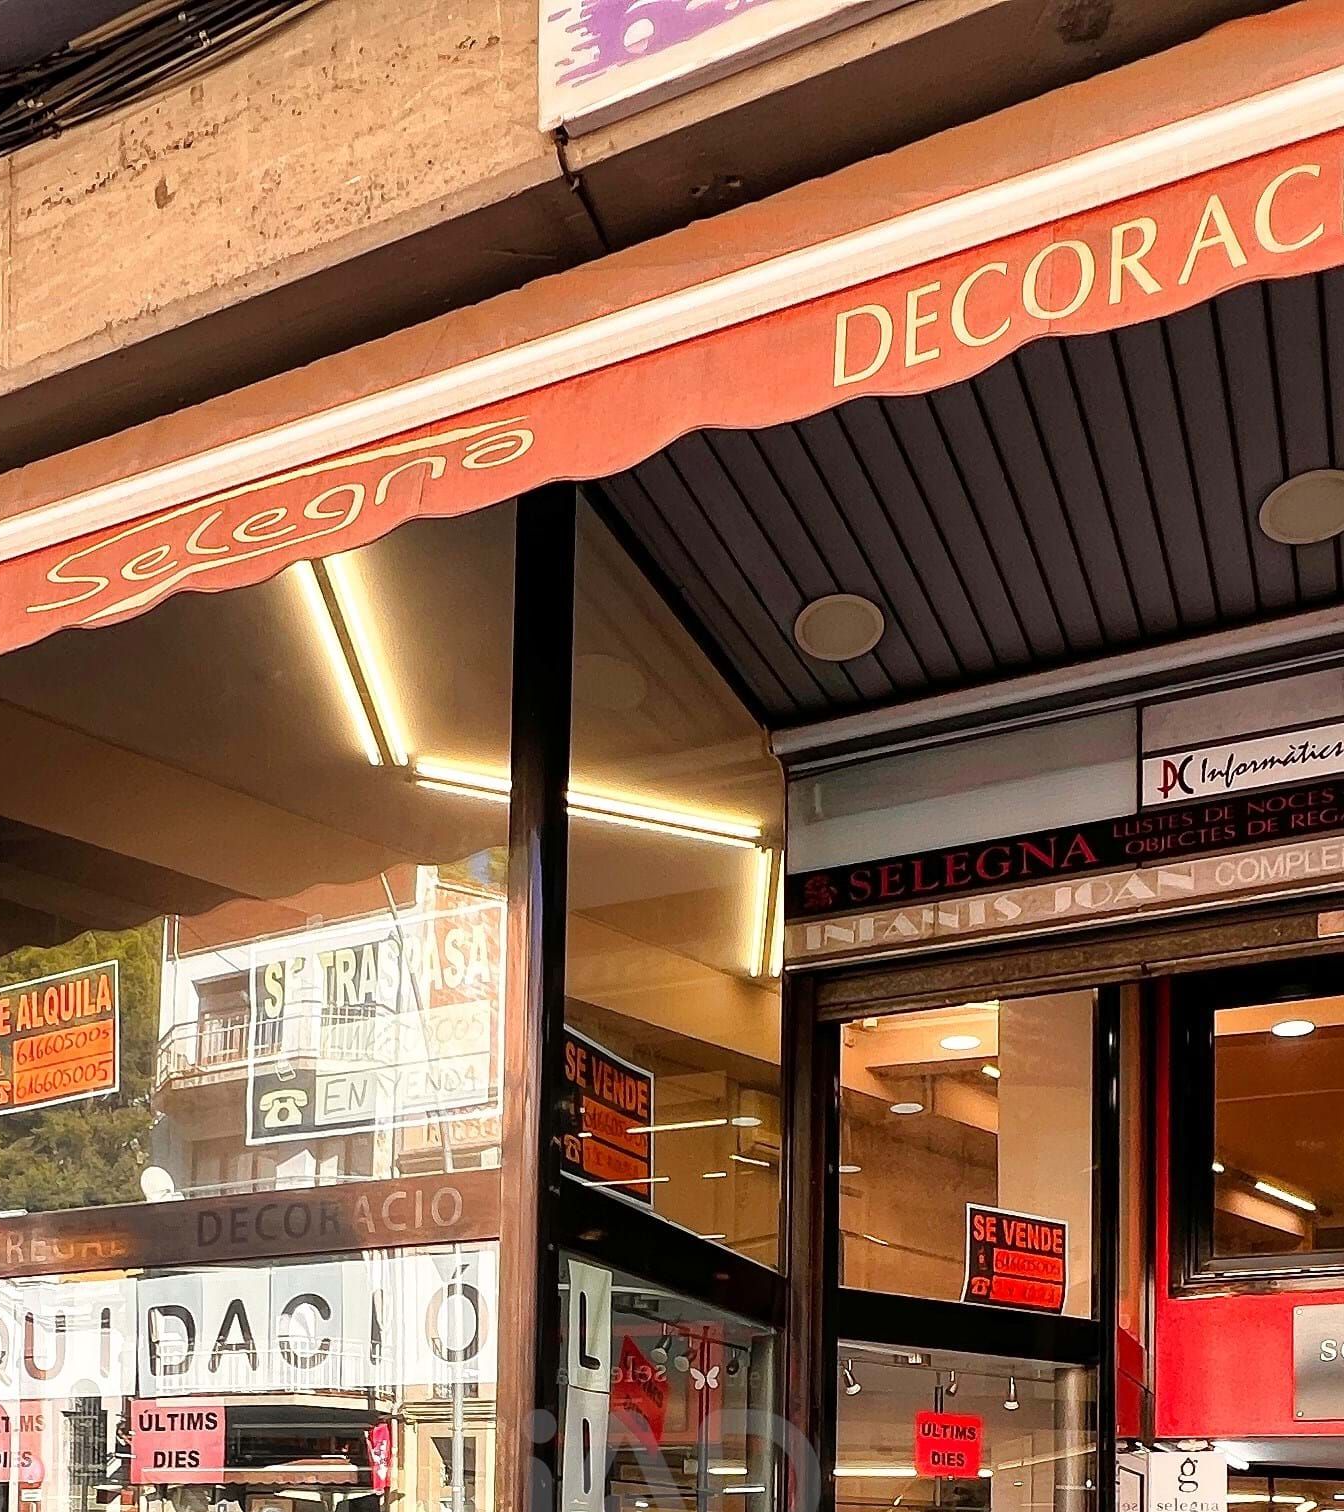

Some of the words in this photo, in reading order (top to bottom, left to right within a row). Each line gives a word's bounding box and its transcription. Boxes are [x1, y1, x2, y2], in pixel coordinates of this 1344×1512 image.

[26, 416, 537, 626] Selegna
[1156, 755, 1195, 800] PC
[1200, 738, 1344, 790] Informàtics
[1204, 805, 1235, 824] DE
[1247, 788, 1335, 816] NOCES
[1124, 825, 1236, 856] OBJECTES
[1248, 819, 1279, 836] DE
[849, 832, 1100, 902] SELEGNA
[1053, 868, 1195, 914] JOAN
[16, 974, 112, 1032] ALQUILA
[16, 1027, 111, 1066] 616605005
[16, 1058, 113, 1099] 616605005
[324, 1079, 368, 1116] EN
[564, 1040, 587, 1089] SE
[591, 1054, 649, 1118] VENDE
[973, 1214, 997, 1243] SE
[1002, 1219, 1063, 1254] VENDE
[138, 1408, 218, 1433] ÚLTIMS
[152, 1448, 201, 1471] DIES
[931, 1451, 965, 1467] DIES
